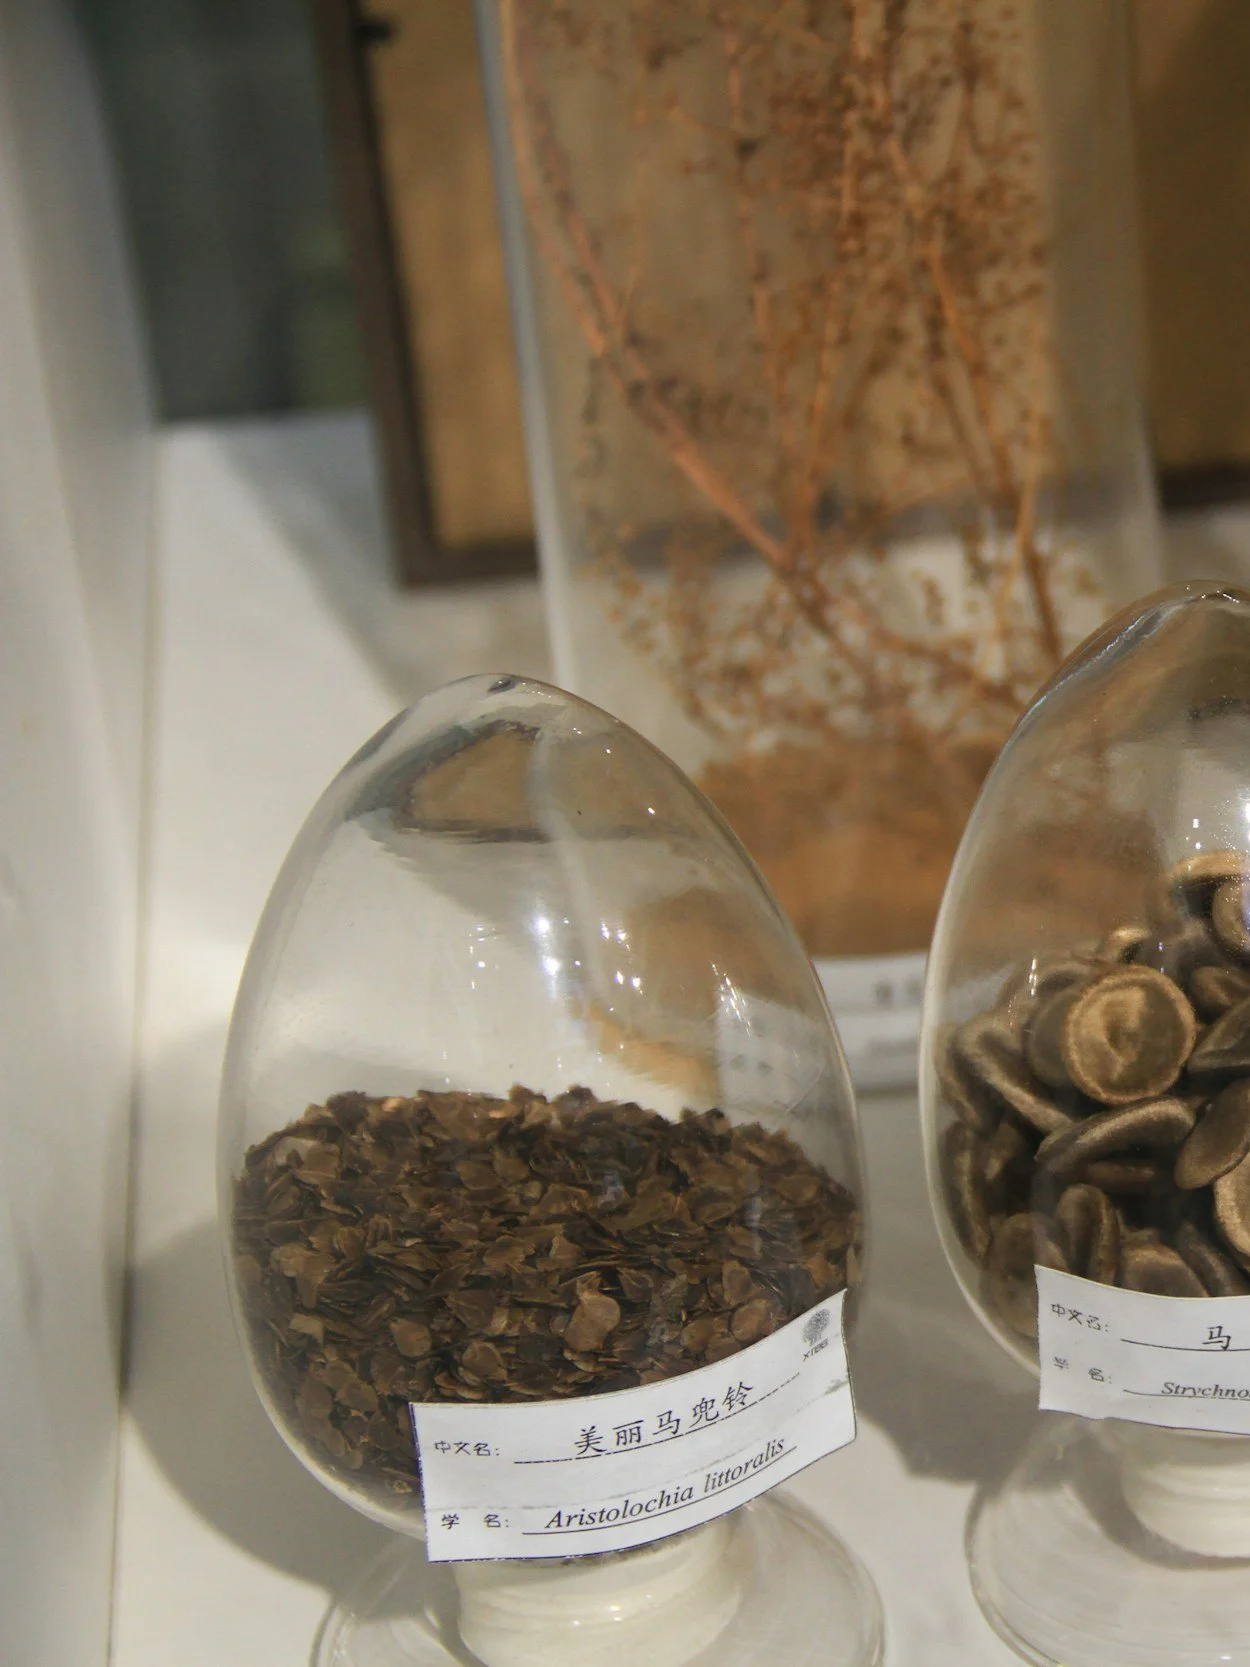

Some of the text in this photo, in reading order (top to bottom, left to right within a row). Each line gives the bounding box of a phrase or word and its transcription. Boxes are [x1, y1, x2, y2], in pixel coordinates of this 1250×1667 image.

[433, 1440, 502, 1458] 中文名:
[573, 1380, 754, 1456] 美丽马兜铃
[544, 1437, 786, 1530] Aristolochia littoralis
